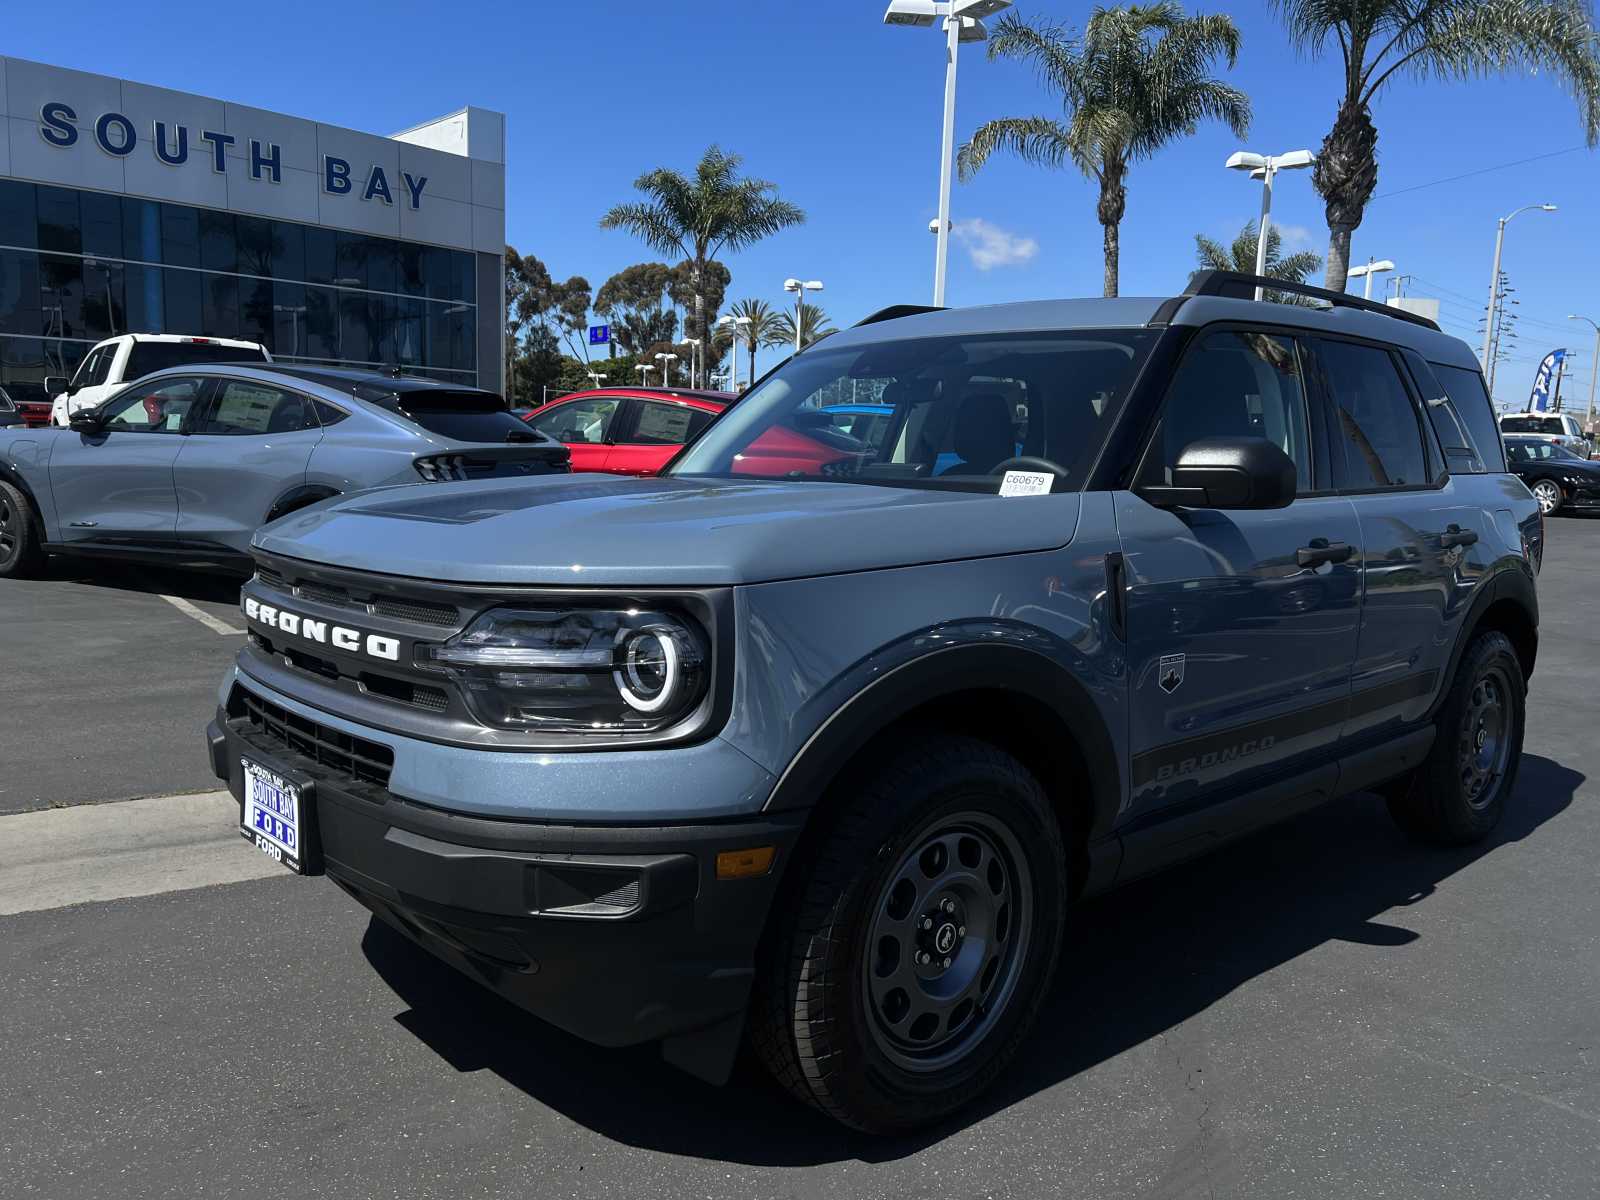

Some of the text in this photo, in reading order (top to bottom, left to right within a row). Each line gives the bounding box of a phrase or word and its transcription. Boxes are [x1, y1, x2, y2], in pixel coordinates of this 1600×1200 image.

[39, 101, 429, 211] SOUTH BAY
[1006, 474, 1045, 486] C60679
[245, 597, 401, 661] BRONCO
[1154, 735, 1276, 783] BRONCO
[254, 780, 294, 820] SOUTH BAY
[254, 807, 295, 847] FORD
[255, 834, 282, 862] FORD
